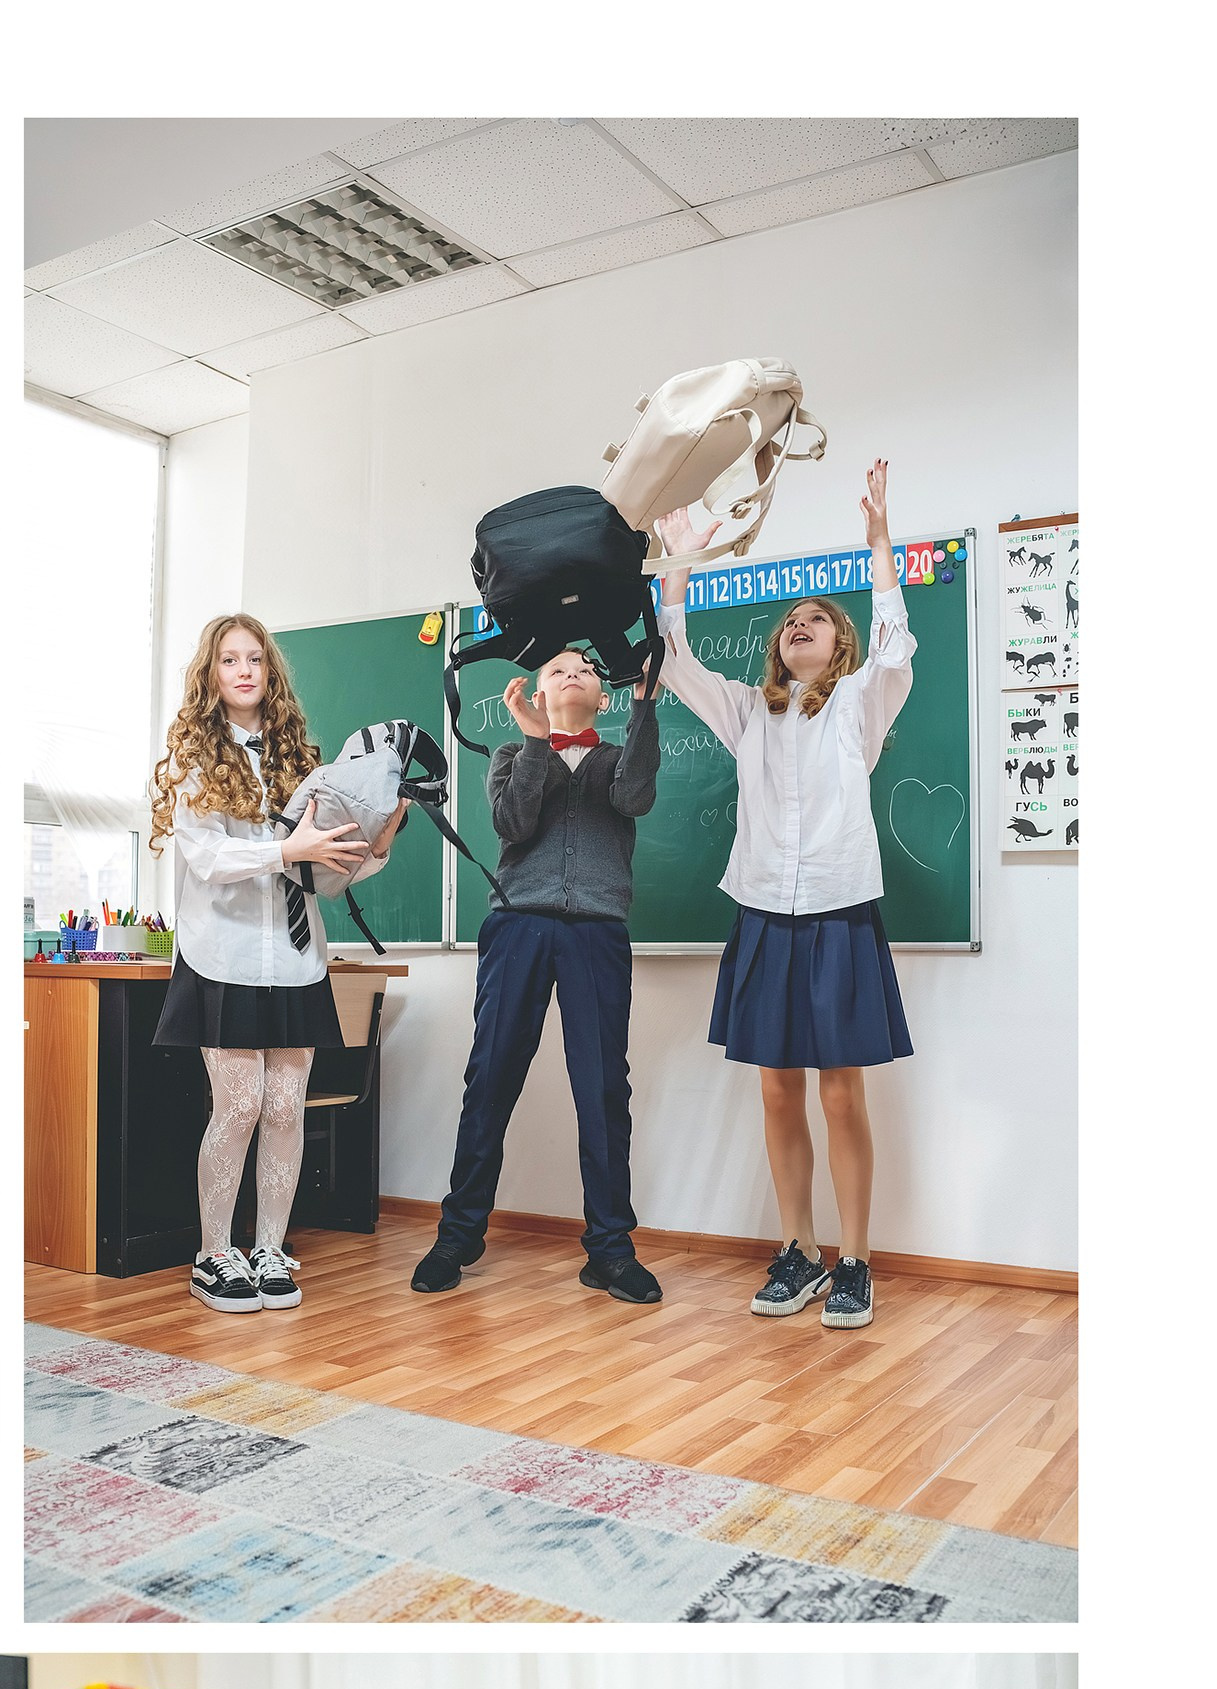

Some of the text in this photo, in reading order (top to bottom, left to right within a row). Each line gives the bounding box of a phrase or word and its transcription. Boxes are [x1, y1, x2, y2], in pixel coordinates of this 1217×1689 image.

[1007, 533, 1055, 544] ЖЕРЕБЯТА
[687, 580, 703, 606] 11
[710, 576, 729, 602] 12
[733, 573, 752, 599] 13
[757, 569, 778, 596] 14
[781, 566, 801, 593] 15
[806, 562, 827, 590] 16
[831, 559, 852, 587] 17
[908, 549, 932, 578] 20
[1007, 582, 1057, 594] ЖУЖЕЛИЦА
[1008, 636, 1057, 647] ЖУРАВЛИ
[1007, 708, 1041, 718] БЫКИ
[1007, 746, 1058, 755] ВЕРБЛЮДЫ
[1015, 801, 1048, 812] ГУСЬ
